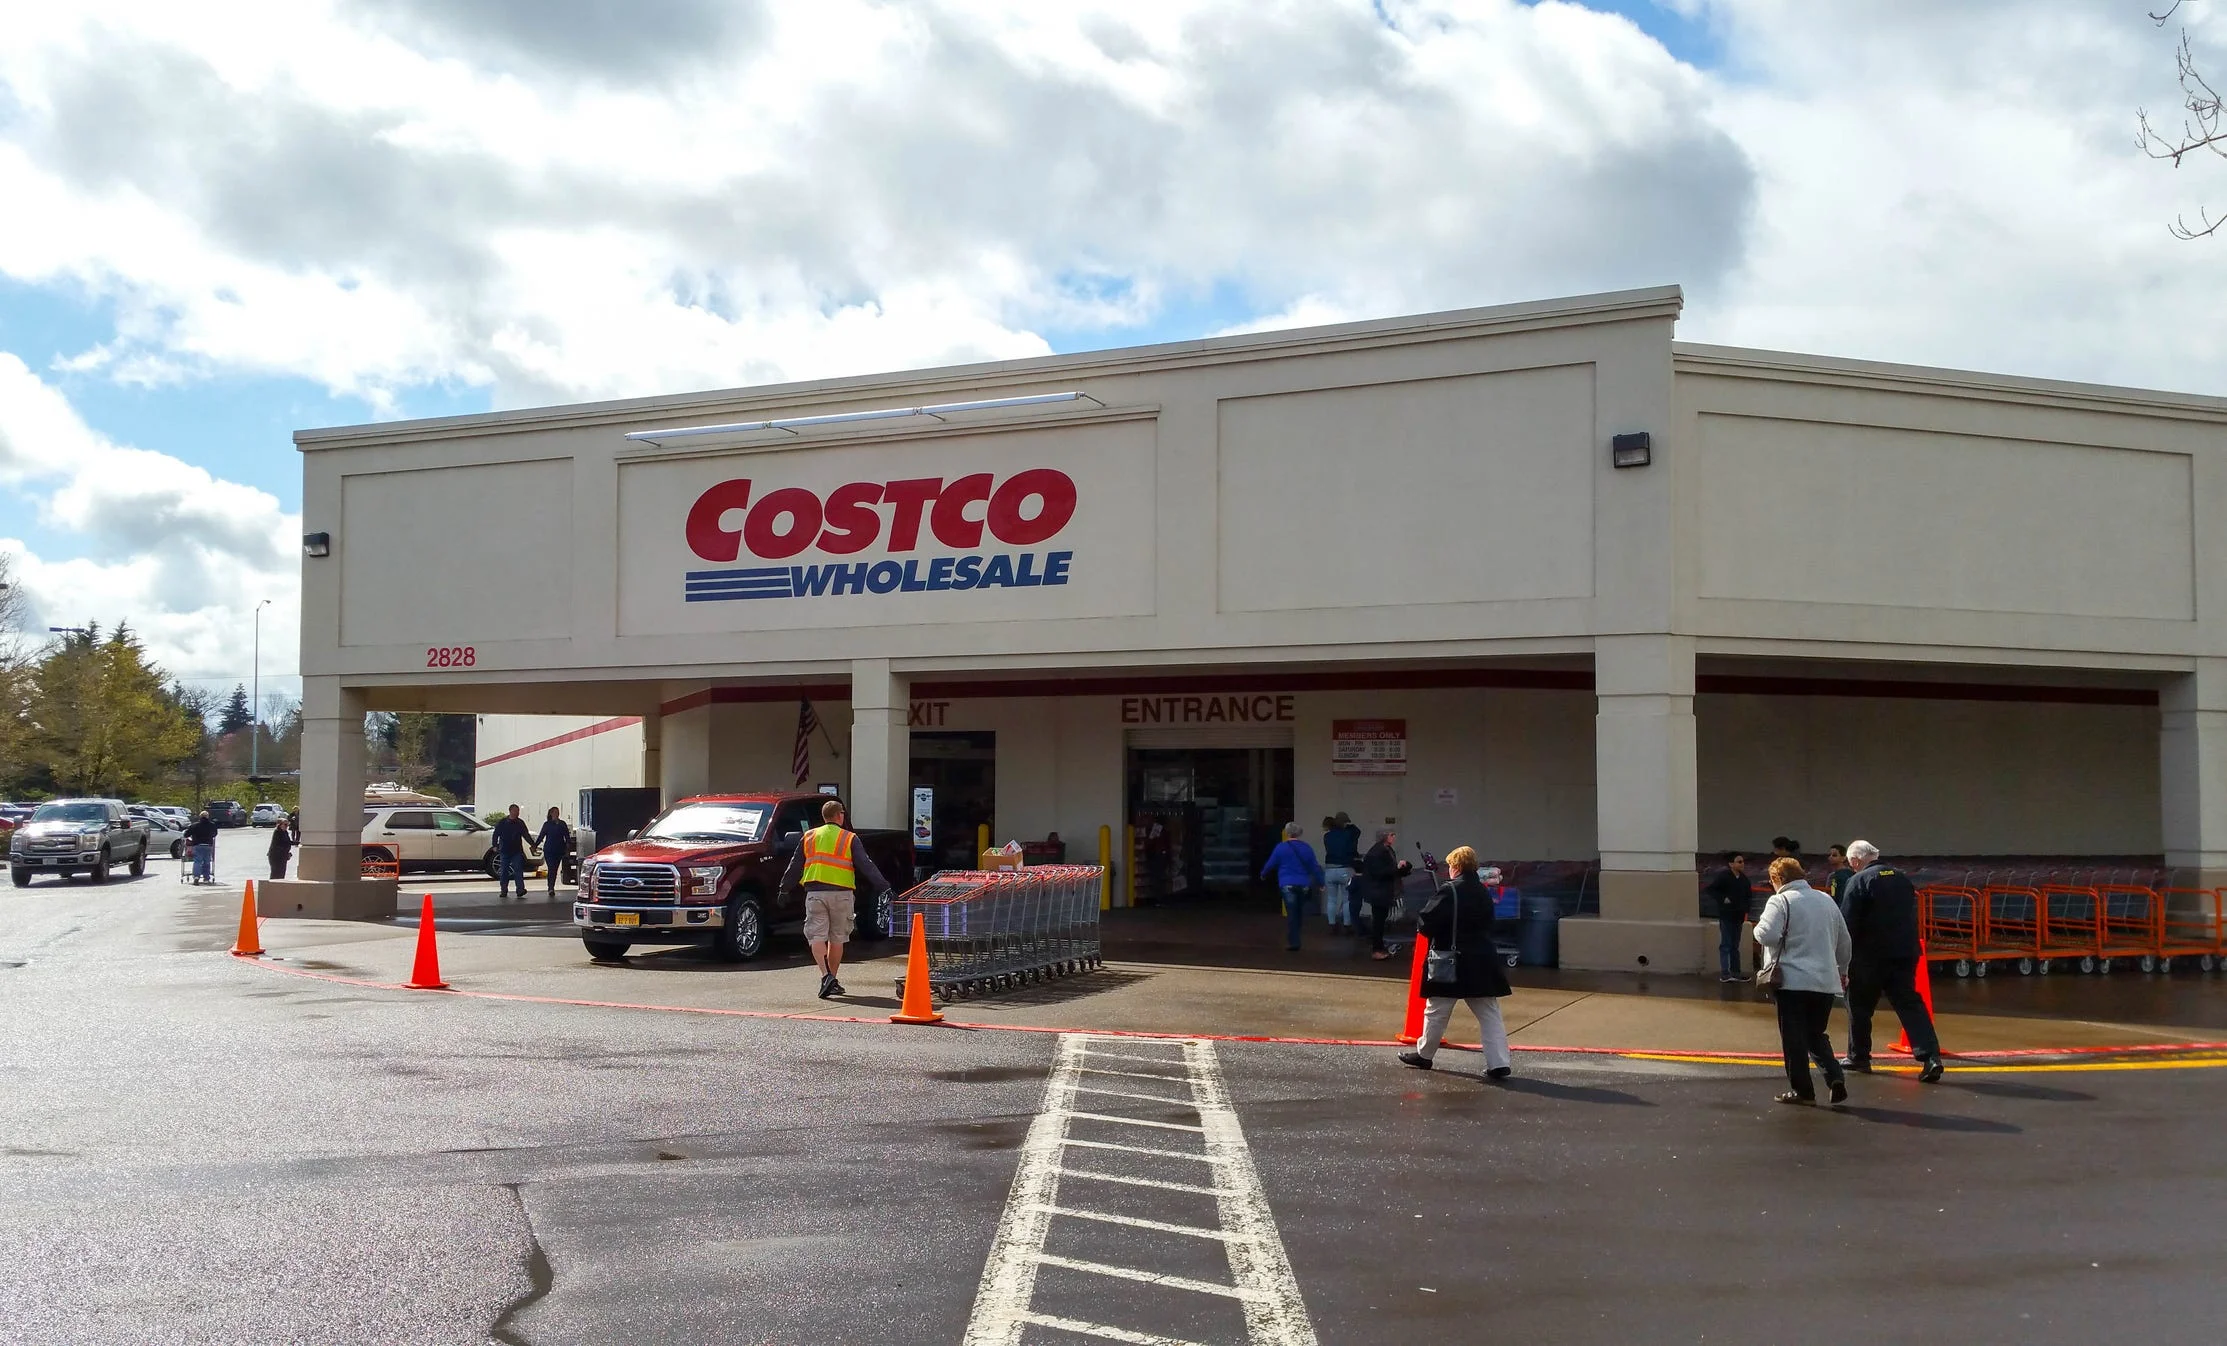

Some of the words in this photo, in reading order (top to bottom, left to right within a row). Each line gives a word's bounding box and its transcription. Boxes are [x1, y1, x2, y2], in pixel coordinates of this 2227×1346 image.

[686, 468, 1077, 562] COSTCO
[789, 551, 1074, 598] WHOLESALE
[427, 647, 475, 667] 2828
[908, 702, 949, 726] XIT
[1121, 695, 1295, 723] ENTRANCE
